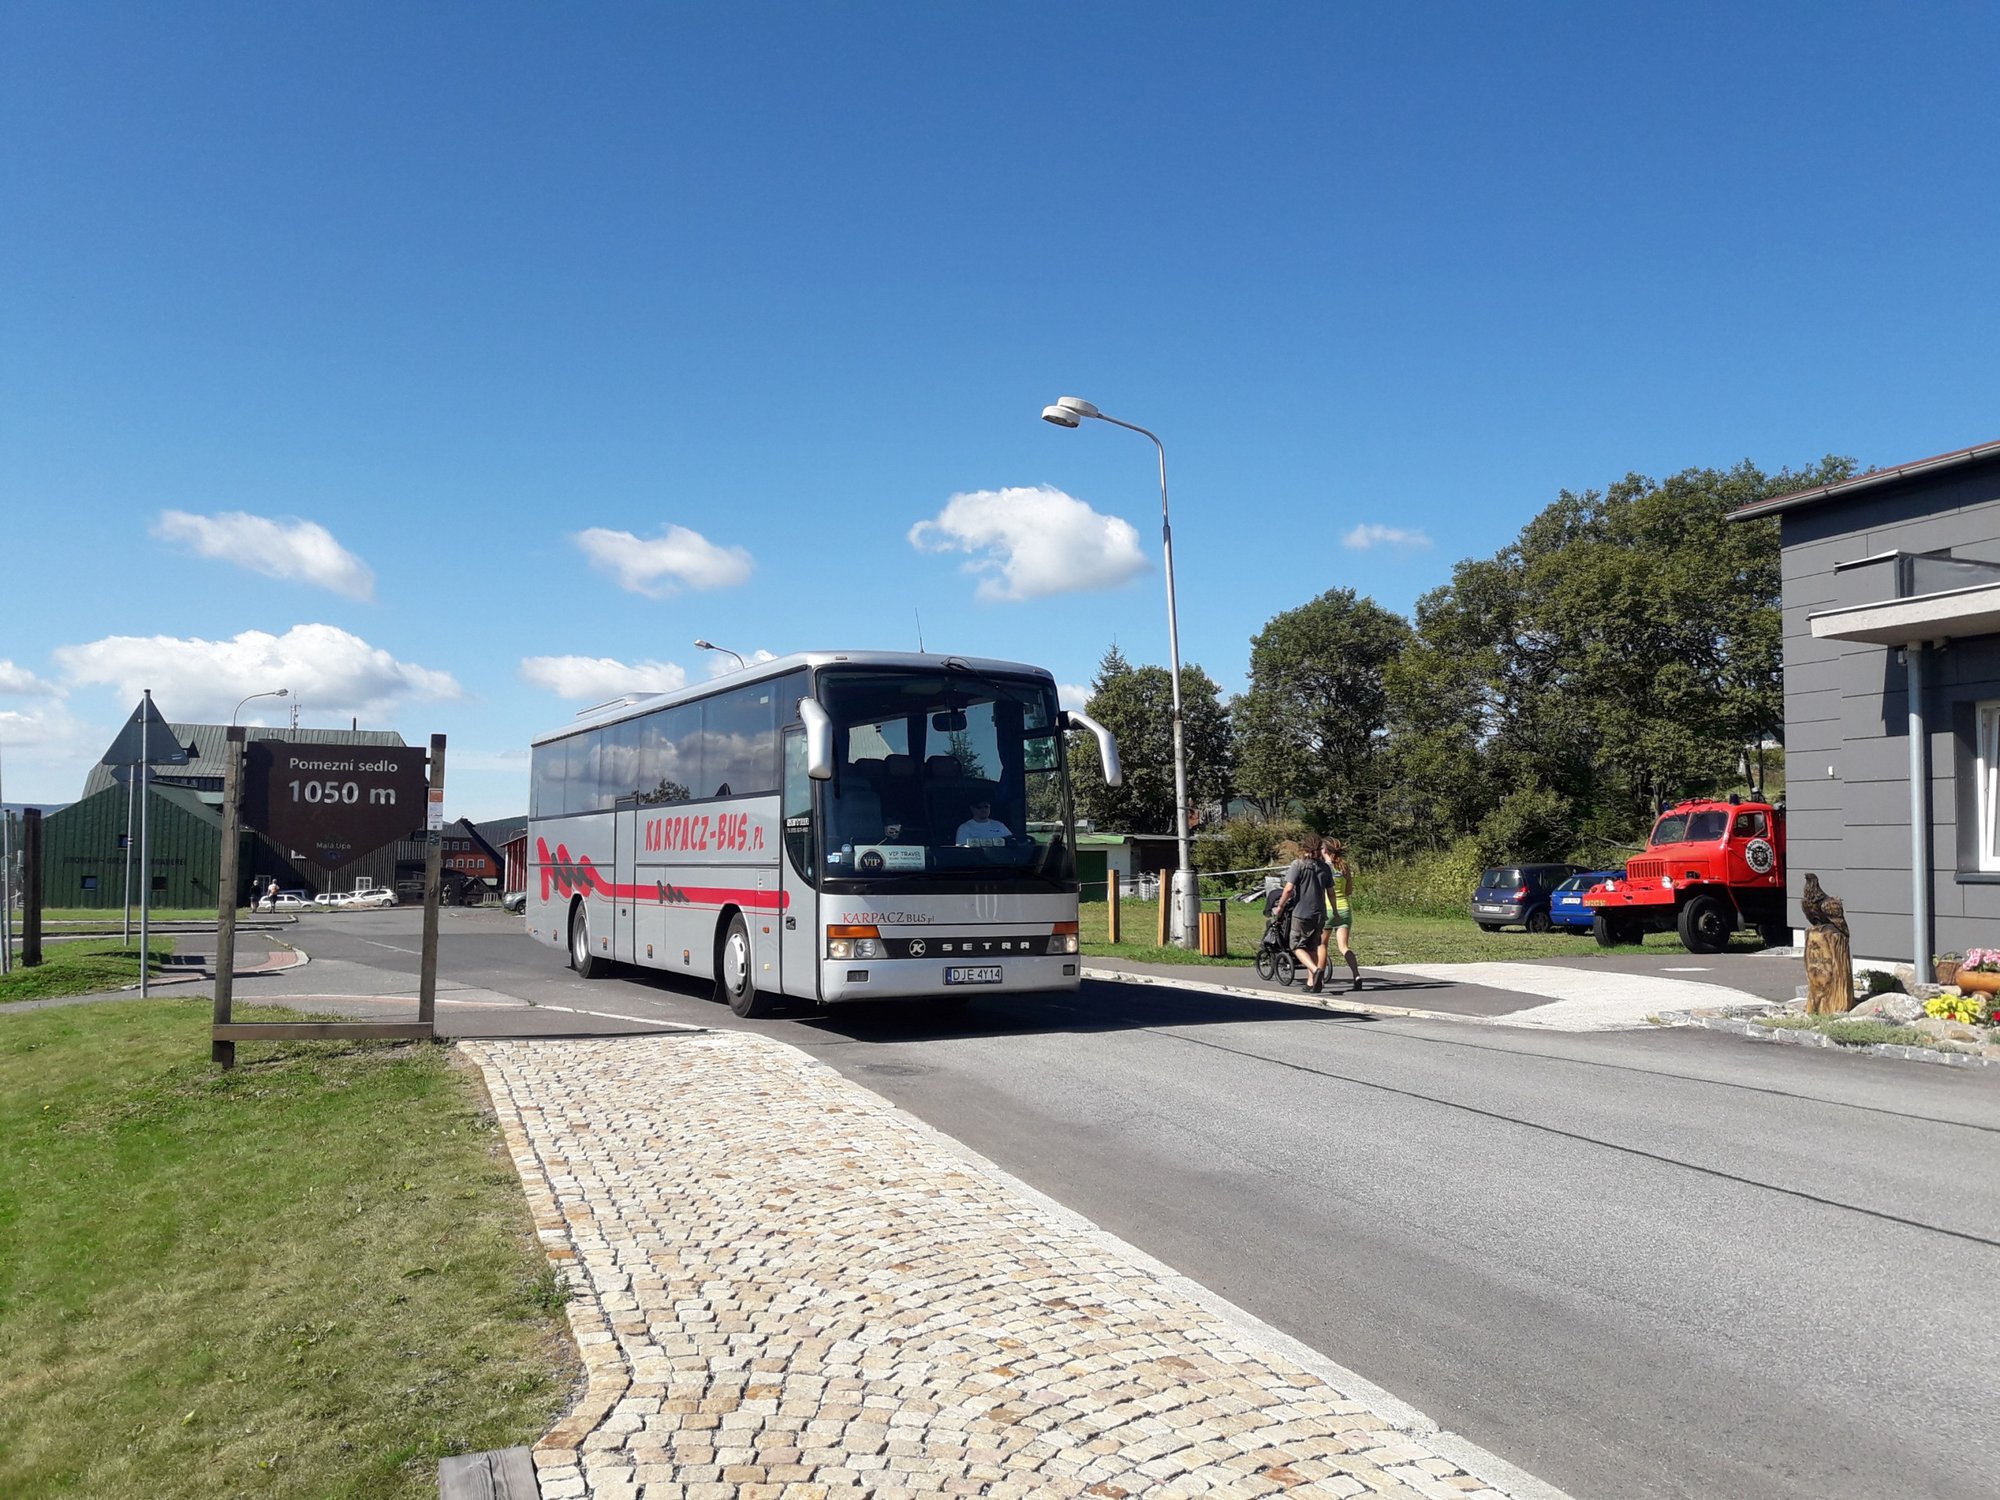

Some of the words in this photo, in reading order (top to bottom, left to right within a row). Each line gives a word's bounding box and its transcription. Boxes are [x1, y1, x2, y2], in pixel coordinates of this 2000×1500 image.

[289, 757, 354, 771] Pomezní
[358, 760, 398, 772] sedlo
[288, 780, 359, 805] 1050
[369, 788, 396, 805] m
[864, 858, 881, 867] VIP
[942, 941, 1030, 951] SETRA
[953, 970, 974, 980] DJE
[977, 969, 1000, 980] 4Y14
